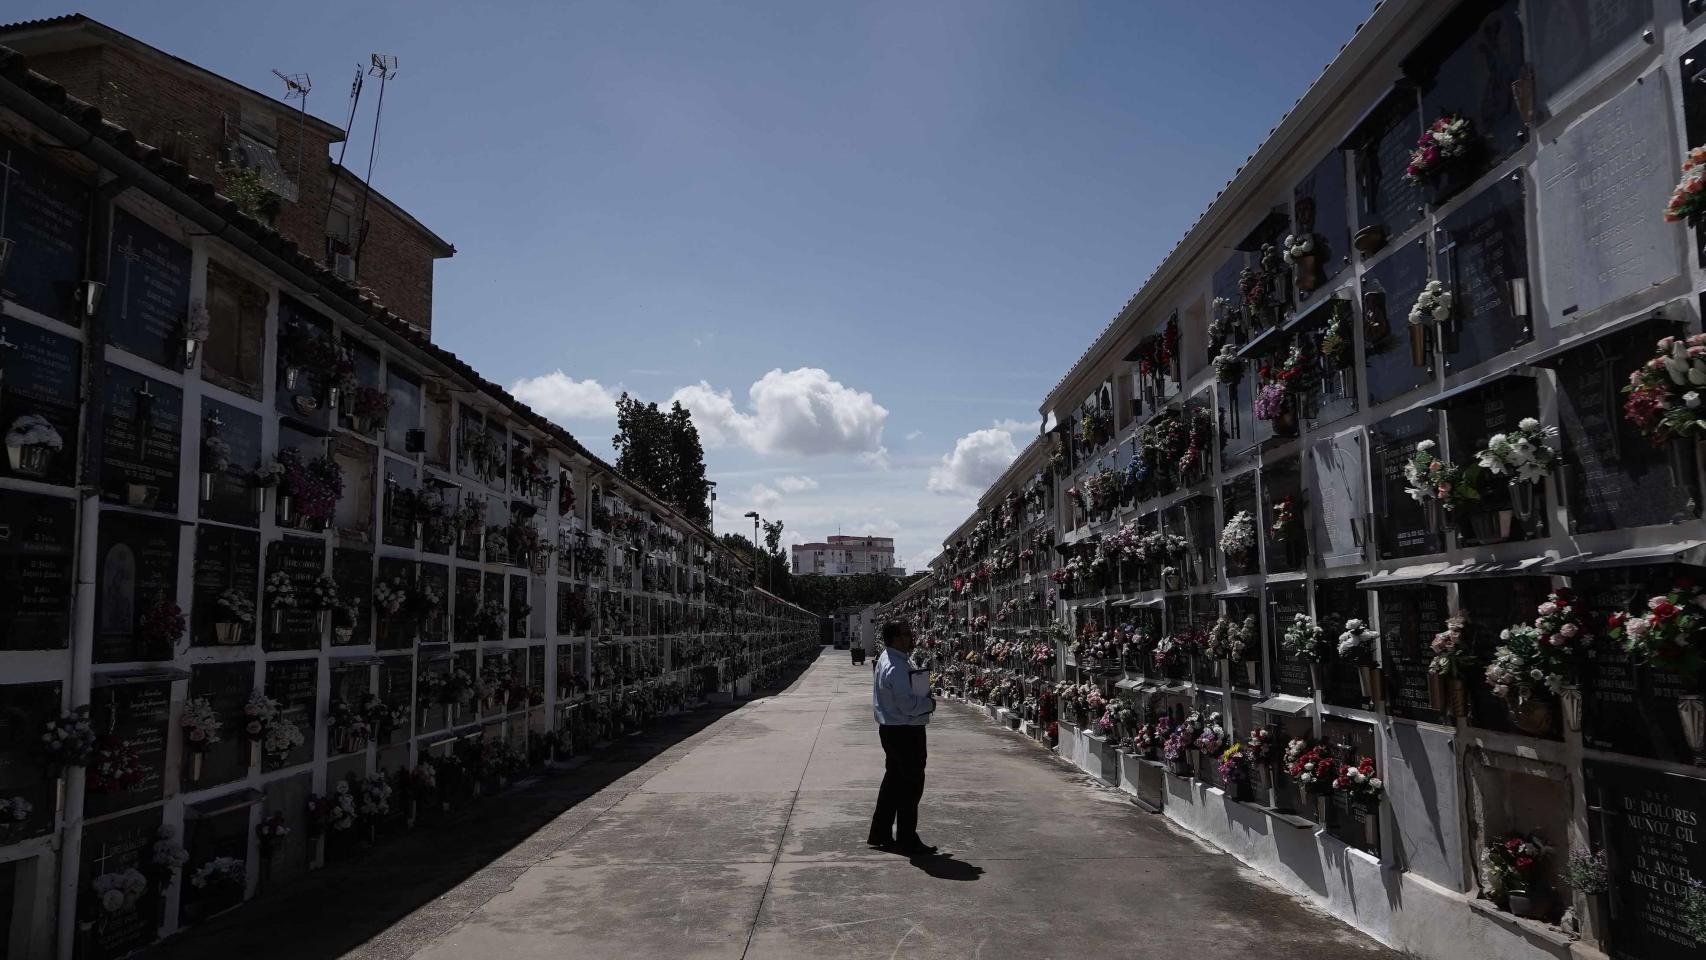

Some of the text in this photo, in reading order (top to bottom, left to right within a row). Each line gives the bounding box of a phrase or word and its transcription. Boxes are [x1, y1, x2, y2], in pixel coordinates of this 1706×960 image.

[1640, 799, 1697, 826] DOLORES
[1675, 825, 1698, 845] GIL
[1630, 869, 1659, 890] ARCE
